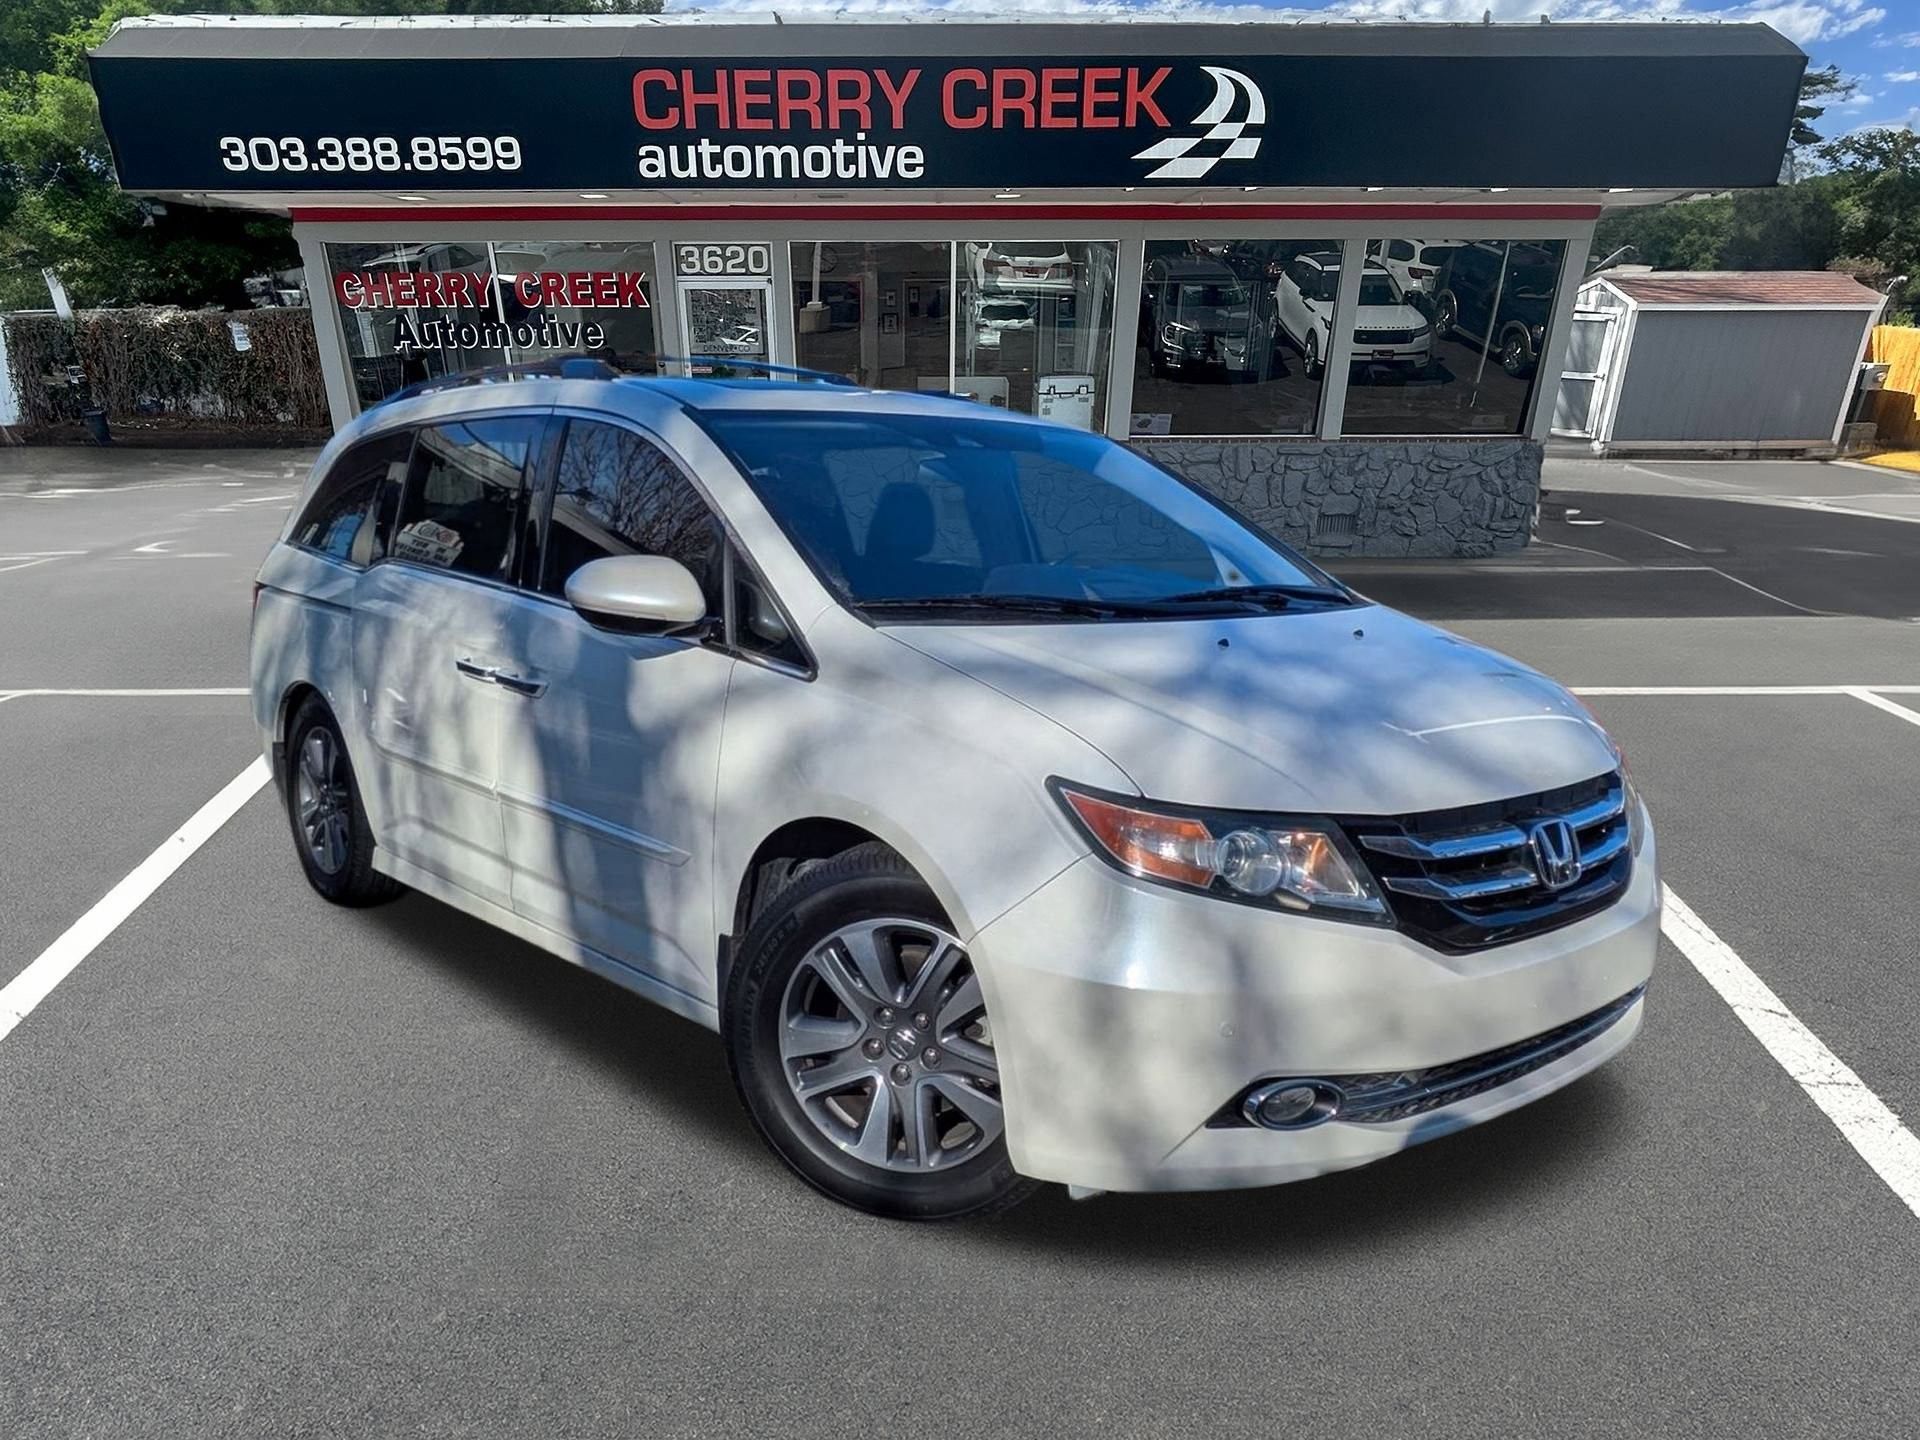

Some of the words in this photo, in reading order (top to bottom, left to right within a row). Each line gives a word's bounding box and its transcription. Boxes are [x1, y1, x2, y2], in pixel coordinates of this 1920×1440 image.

[632, 68, 921, 130] CHERRY
[942, 67, 1172, 128] CREEK
[219, 135, 522, 172] 303.388.8599
[638, 132, 924, 179] automotive
[680, 245, 769, 274] 3620
[335, 272, 492, 308] CHERRY
[514, 271, 650, 308] CREEK
[392, 311, 604, 350] Automotive
